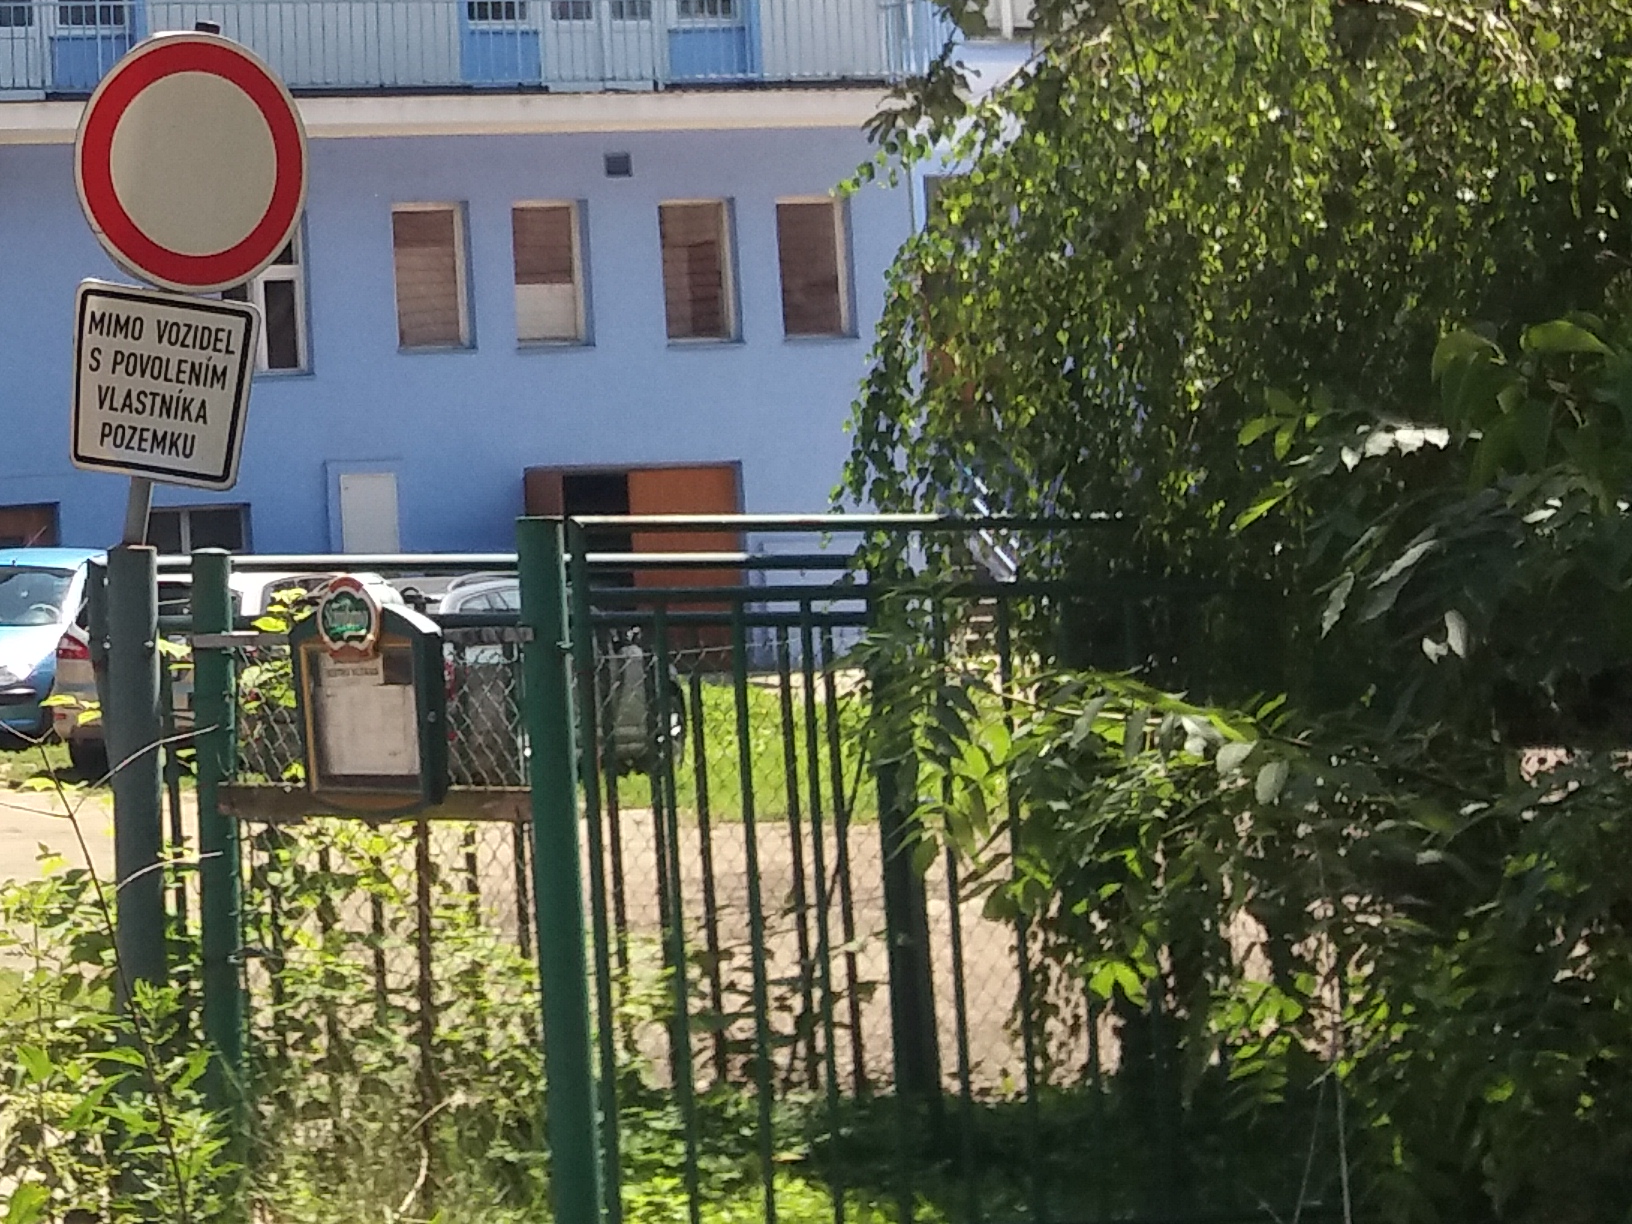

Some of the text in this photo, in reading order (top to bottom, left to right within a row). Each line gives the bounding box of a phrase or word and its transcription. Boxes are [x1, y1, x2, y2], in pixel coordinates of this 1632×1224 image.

[88, 310, 236, 355] MIMO VOZIDEL
[89, 347, 228, 391] S POVOLENÍM
[97, 384, 208, 425] VLASTNÍKA
[99, 422, 197, 459] POZEMKU
